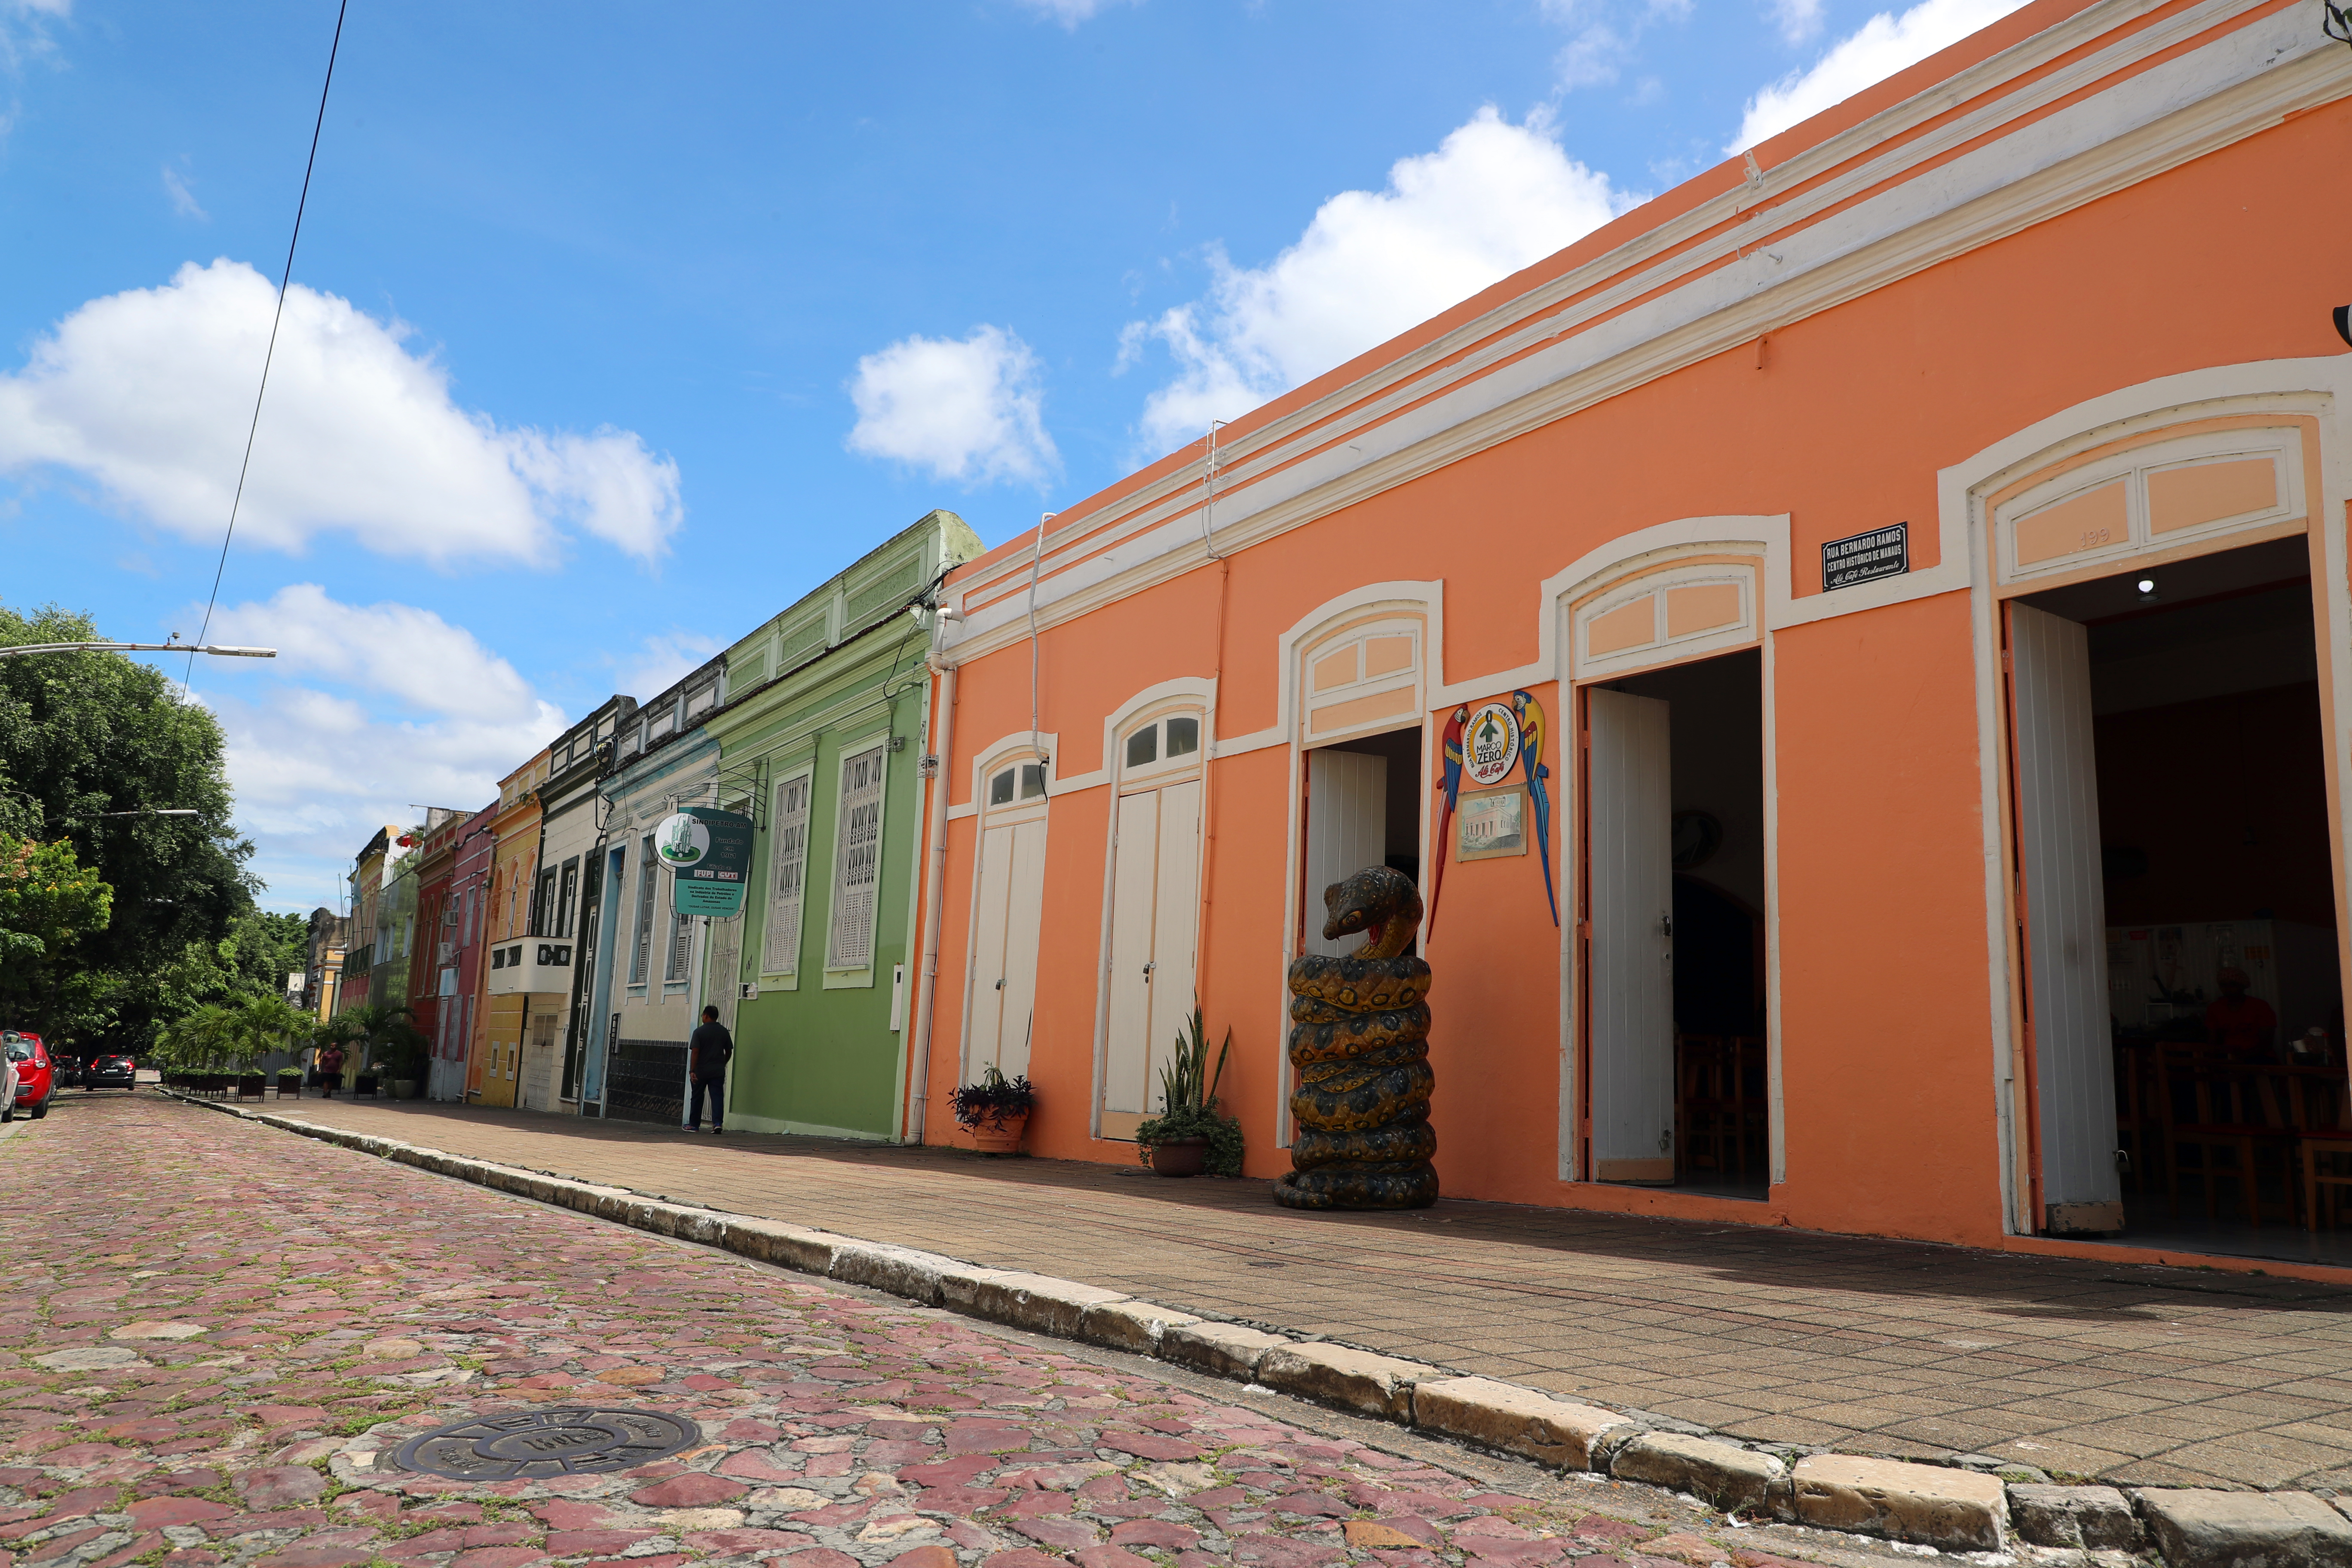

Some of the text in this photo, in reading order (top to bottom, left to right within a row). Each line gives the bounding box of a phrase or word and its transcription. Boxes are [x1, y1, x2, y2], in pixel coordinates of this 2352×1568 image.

[1827, 529, 1901, 559] RUA BERNARDO RAMOS
[2080, 527, 2109, 547] 199
[1827, 545, 1901, 573] CENTRO HISTÓRICO DE MANAUS
[1845, 569, 1859, 581] Café
[1859, 560, 1899, 577] Restaurante
[1470, 712, 1482, 728] RAMOS
[1498, 708, 1515, 761] CENTRO HISTÓRICO
[1476, 741, 1501, 753] MARCO
[1477, 750, 1501, 764] ZERO
[1490, 761, 1504, 775] Café
[692, 818, 746, 828] SINDIPETRO-AM
